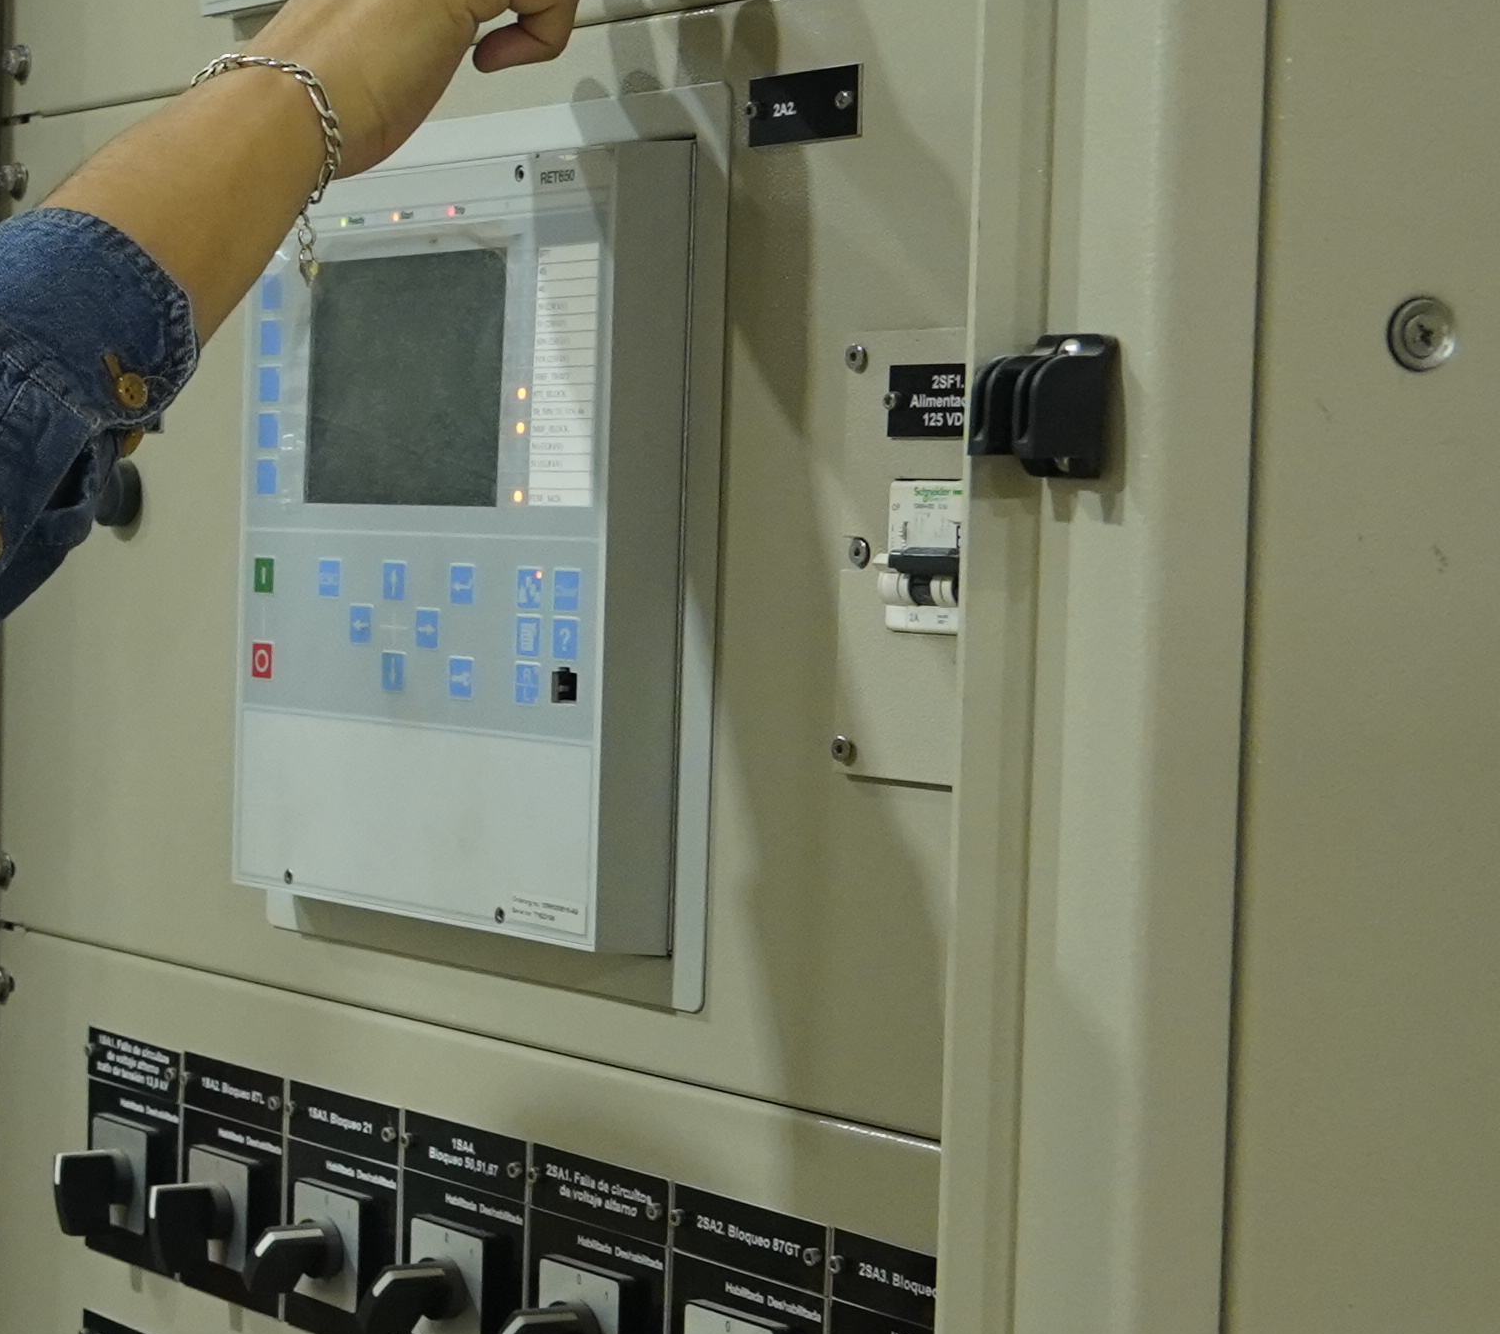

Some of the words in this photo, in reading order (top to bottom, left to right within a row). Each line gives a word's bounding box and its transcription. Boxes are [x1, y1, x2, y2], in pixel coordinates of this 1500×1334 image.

[539, 168, 576, 185] RET650
[931, 375, 965, 389] 2SF1.
[923, 412, 944, 427] 125
[330, 1113, 362, 1133] Bloqueo
[428, 1145, 463, 1167] Bloqueo
[546, 1163, 572, 1183] 2SA1.
[573, 1171, 596, 1190] Falla
[727, 1225, 770, 1249] Bloqueo
[771, 1237, 801, 1258] 87GT
[858, 1262, 890, 1284] 2SA3.
